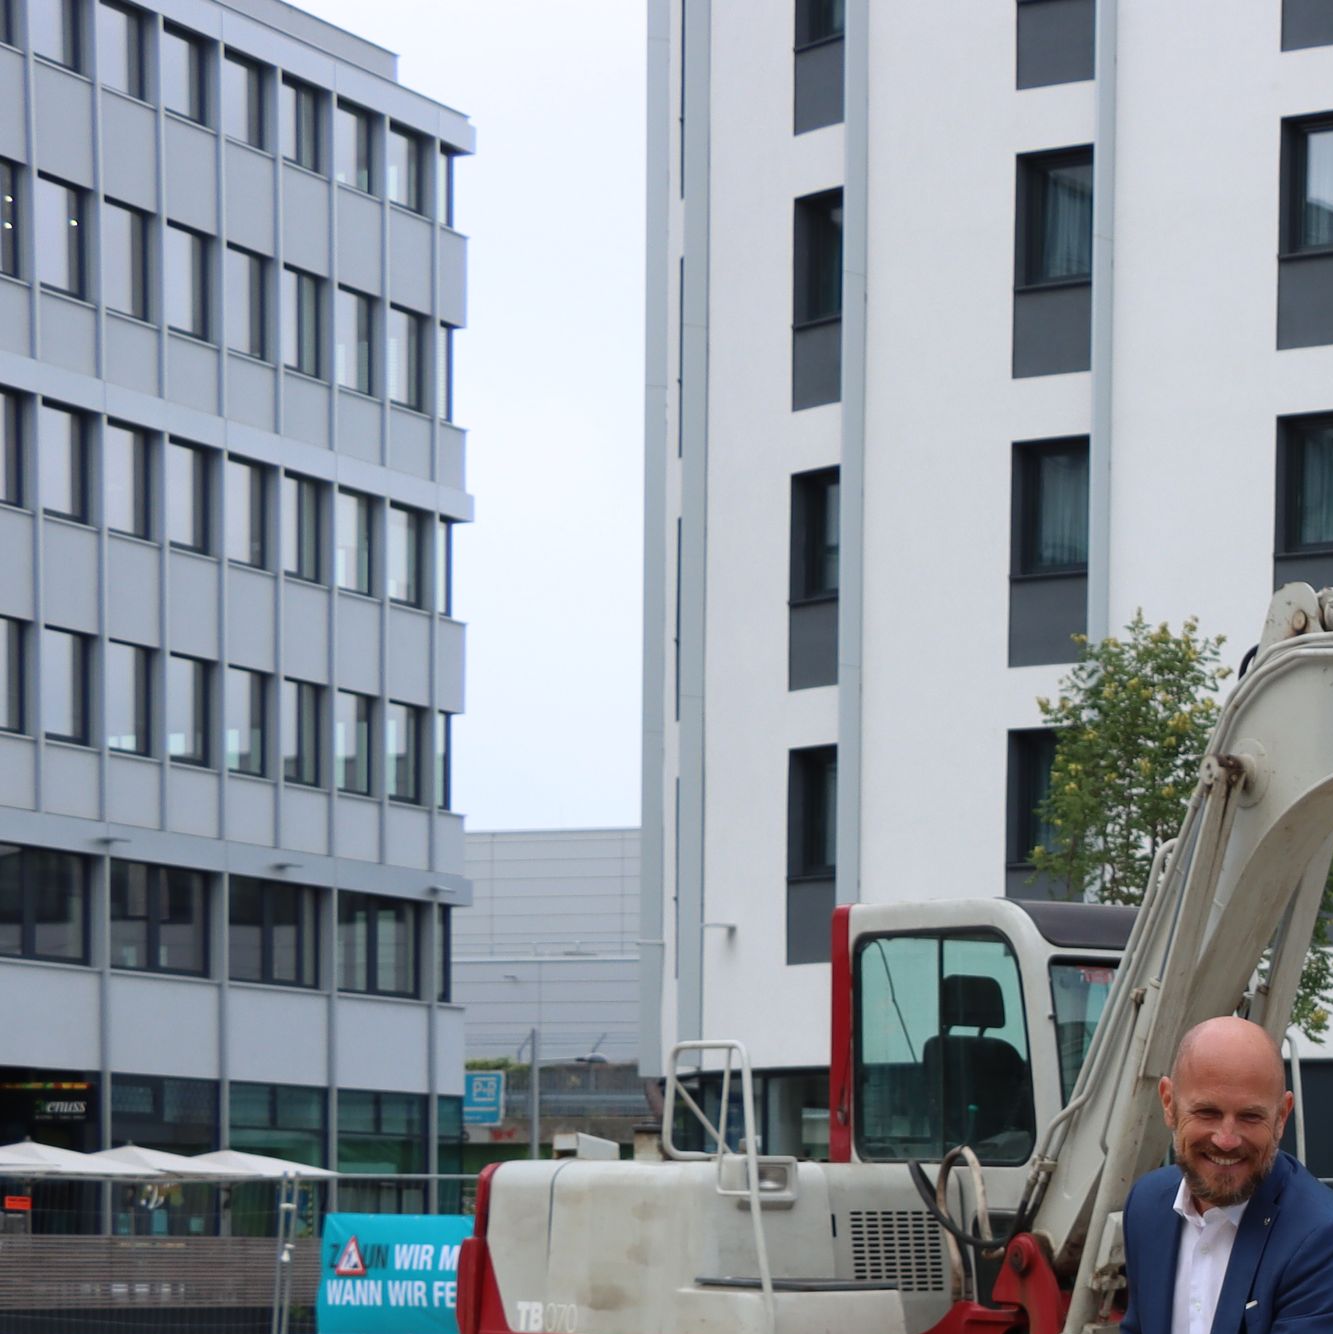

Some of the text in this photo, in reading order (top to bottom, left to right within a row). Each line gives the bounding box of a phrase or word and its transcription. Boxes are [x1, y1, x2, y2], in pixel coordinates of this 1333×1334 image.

[394, 1243, 434, 1271] WIR
[326, 1279, 457, 1308] WANN WIR FE
